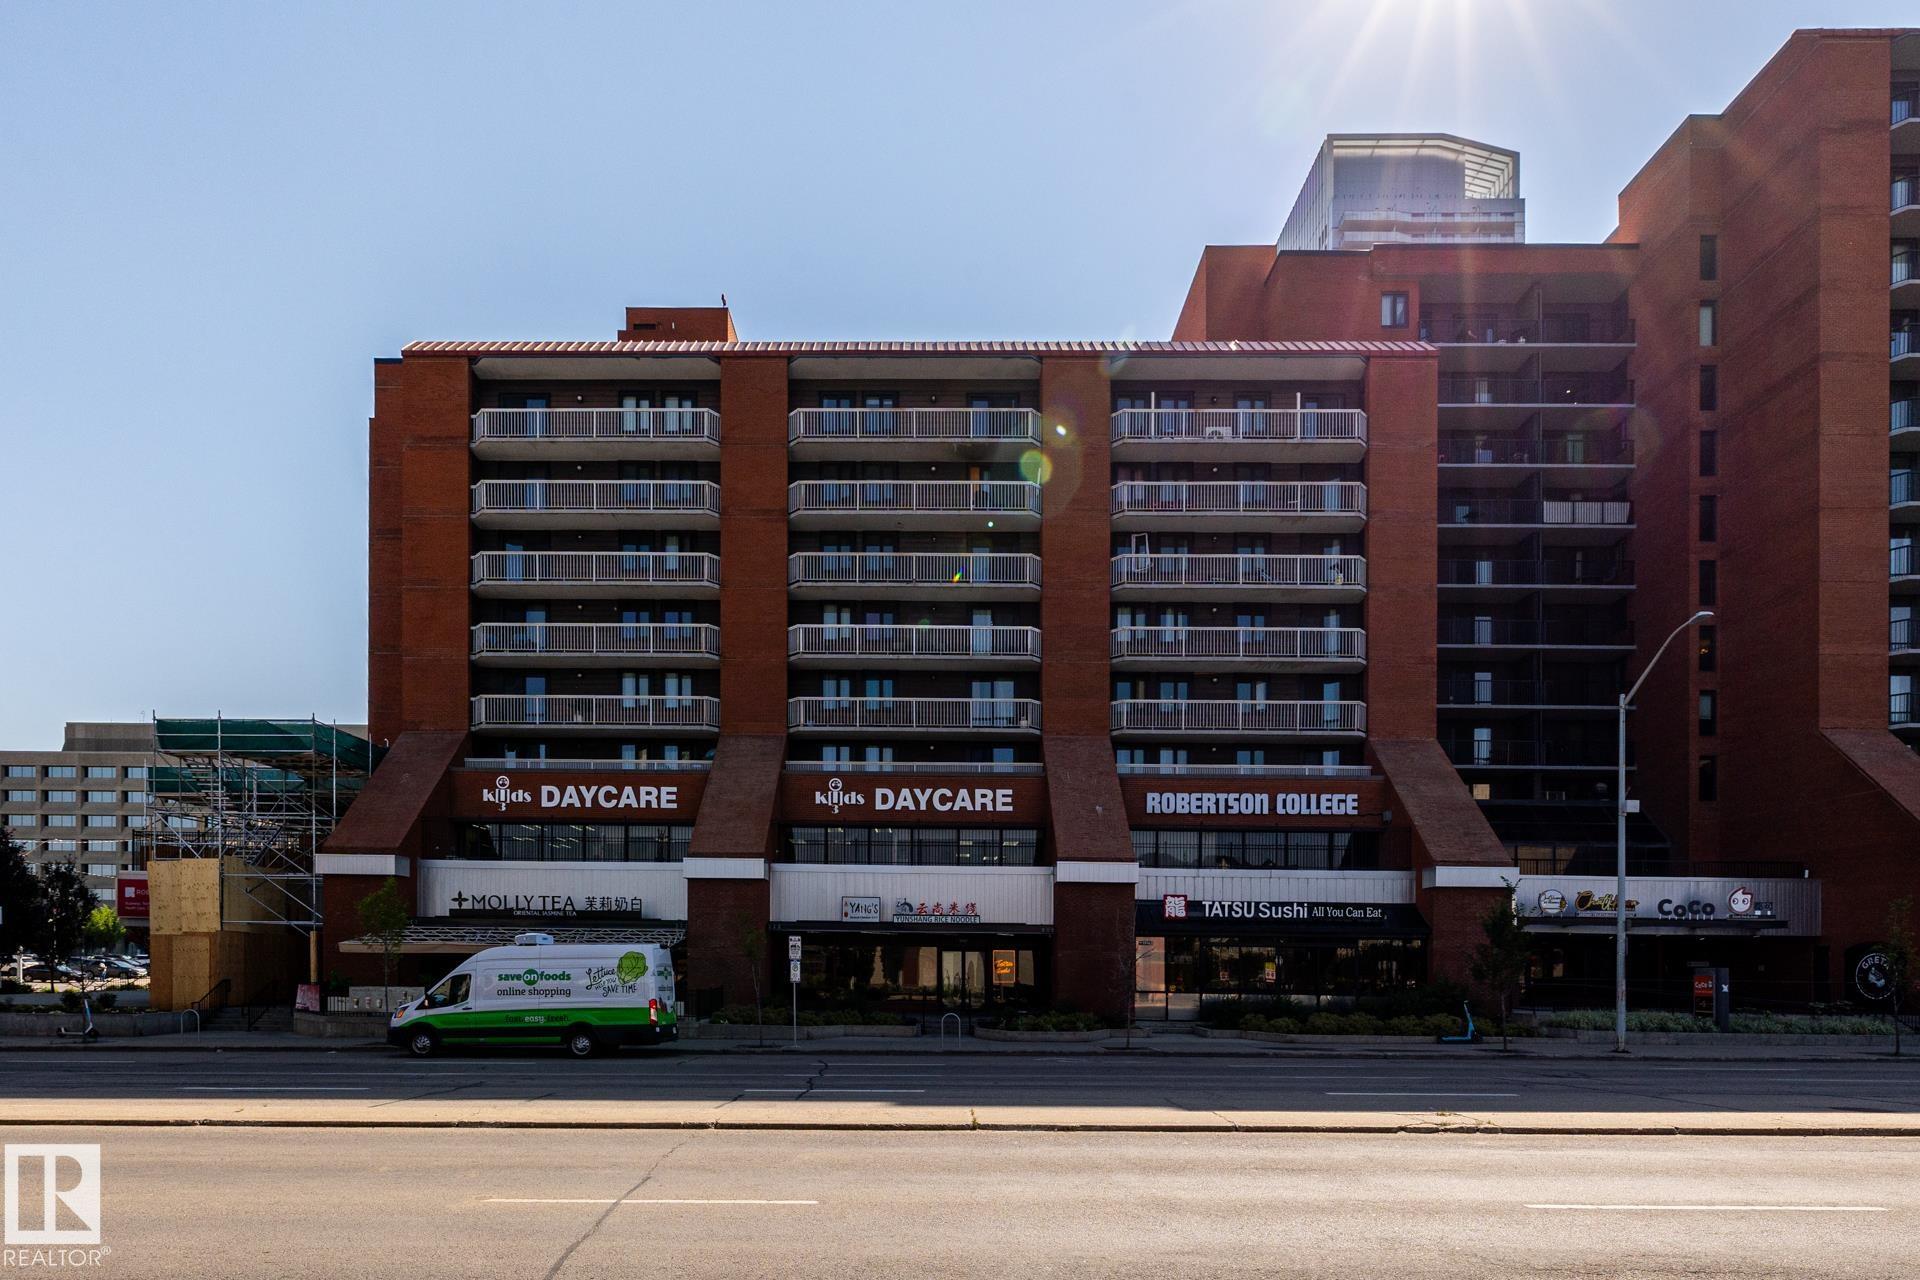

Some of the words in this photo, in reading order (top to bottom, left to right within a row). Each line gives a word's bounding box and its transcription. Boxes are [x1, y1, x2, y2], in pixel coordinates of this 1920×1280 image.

[540, 785, 678, 809] DAYCARE
[875, 788, 1013, 812] DAYCARE
[1146, 792, 1269, 815] ROBERTSON
[1276, 793, 1358, 815] COLLEGE
[471, 894, 534, 911] MOLLY
[538, 895, 576, 912] TEA
[585, 895, 643, 912] 茉莉奶白
[849, 902, 879, 914] YANG'S
[1202, 901, 1255, 918] TATSU
[1258, 902, 1308, 919] Sushi
[1312, 906, 1324, 917] All
[1326, 907, 1343, 917] You
[1345, 907, 1364, 918] Can
[1366, 907, 1382, 918] Eat
[1657, 898, 1716, 917] CoCo
[585, 966, 616, 990] Lettuce
[497, 987, 526, 996] online
[528, 987, 571, 998] shopping
[602, 983, 619, 997] SAVE
[621, 983, 638, 994] TIME
